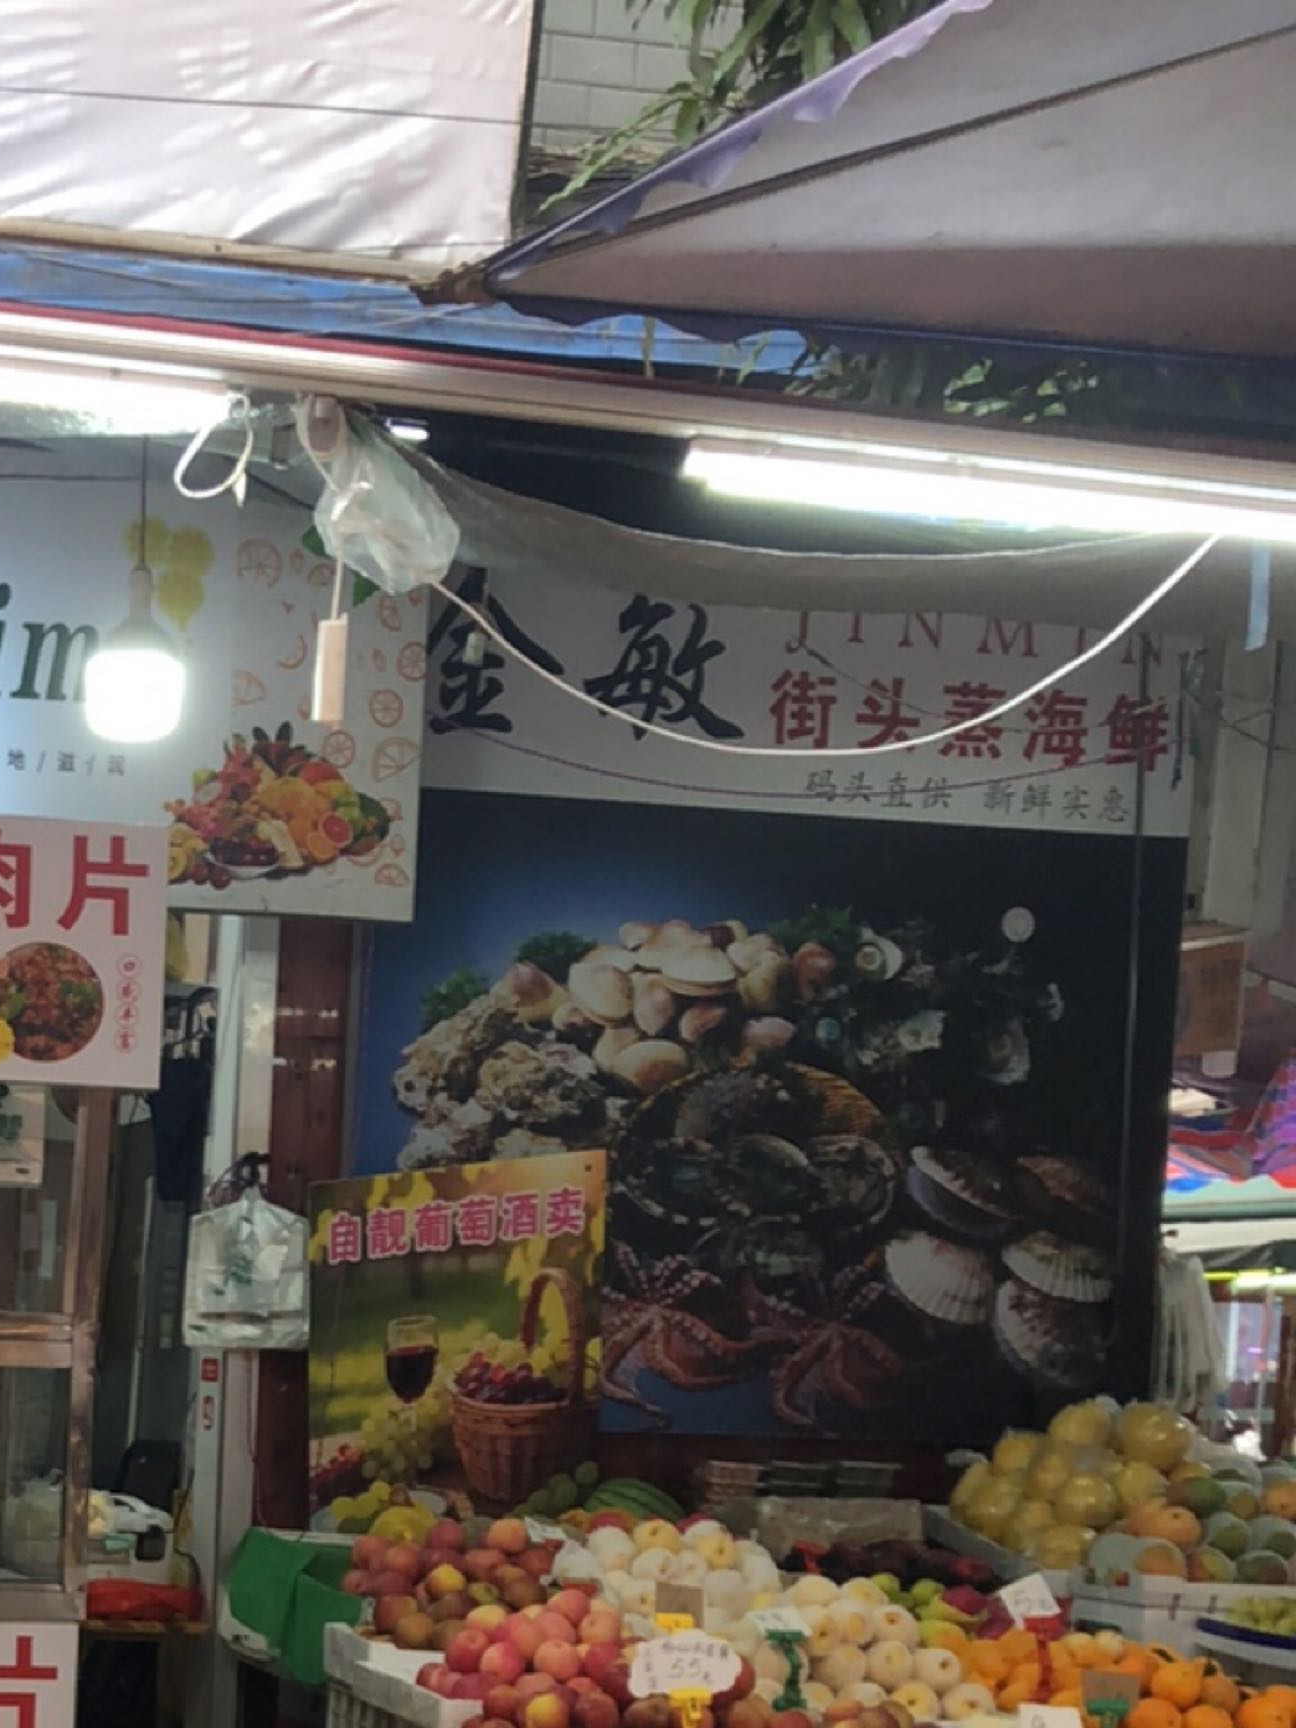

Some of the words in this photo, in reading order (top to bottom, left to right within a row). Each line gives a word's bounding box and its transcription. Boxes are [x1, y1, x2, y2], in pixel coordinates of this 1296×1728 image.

[428, 567, 745, 740] 金敏
[769, 669, 1170, 772] 街头蒸海鲜
[805, 769, 953, 809] 码头直供
